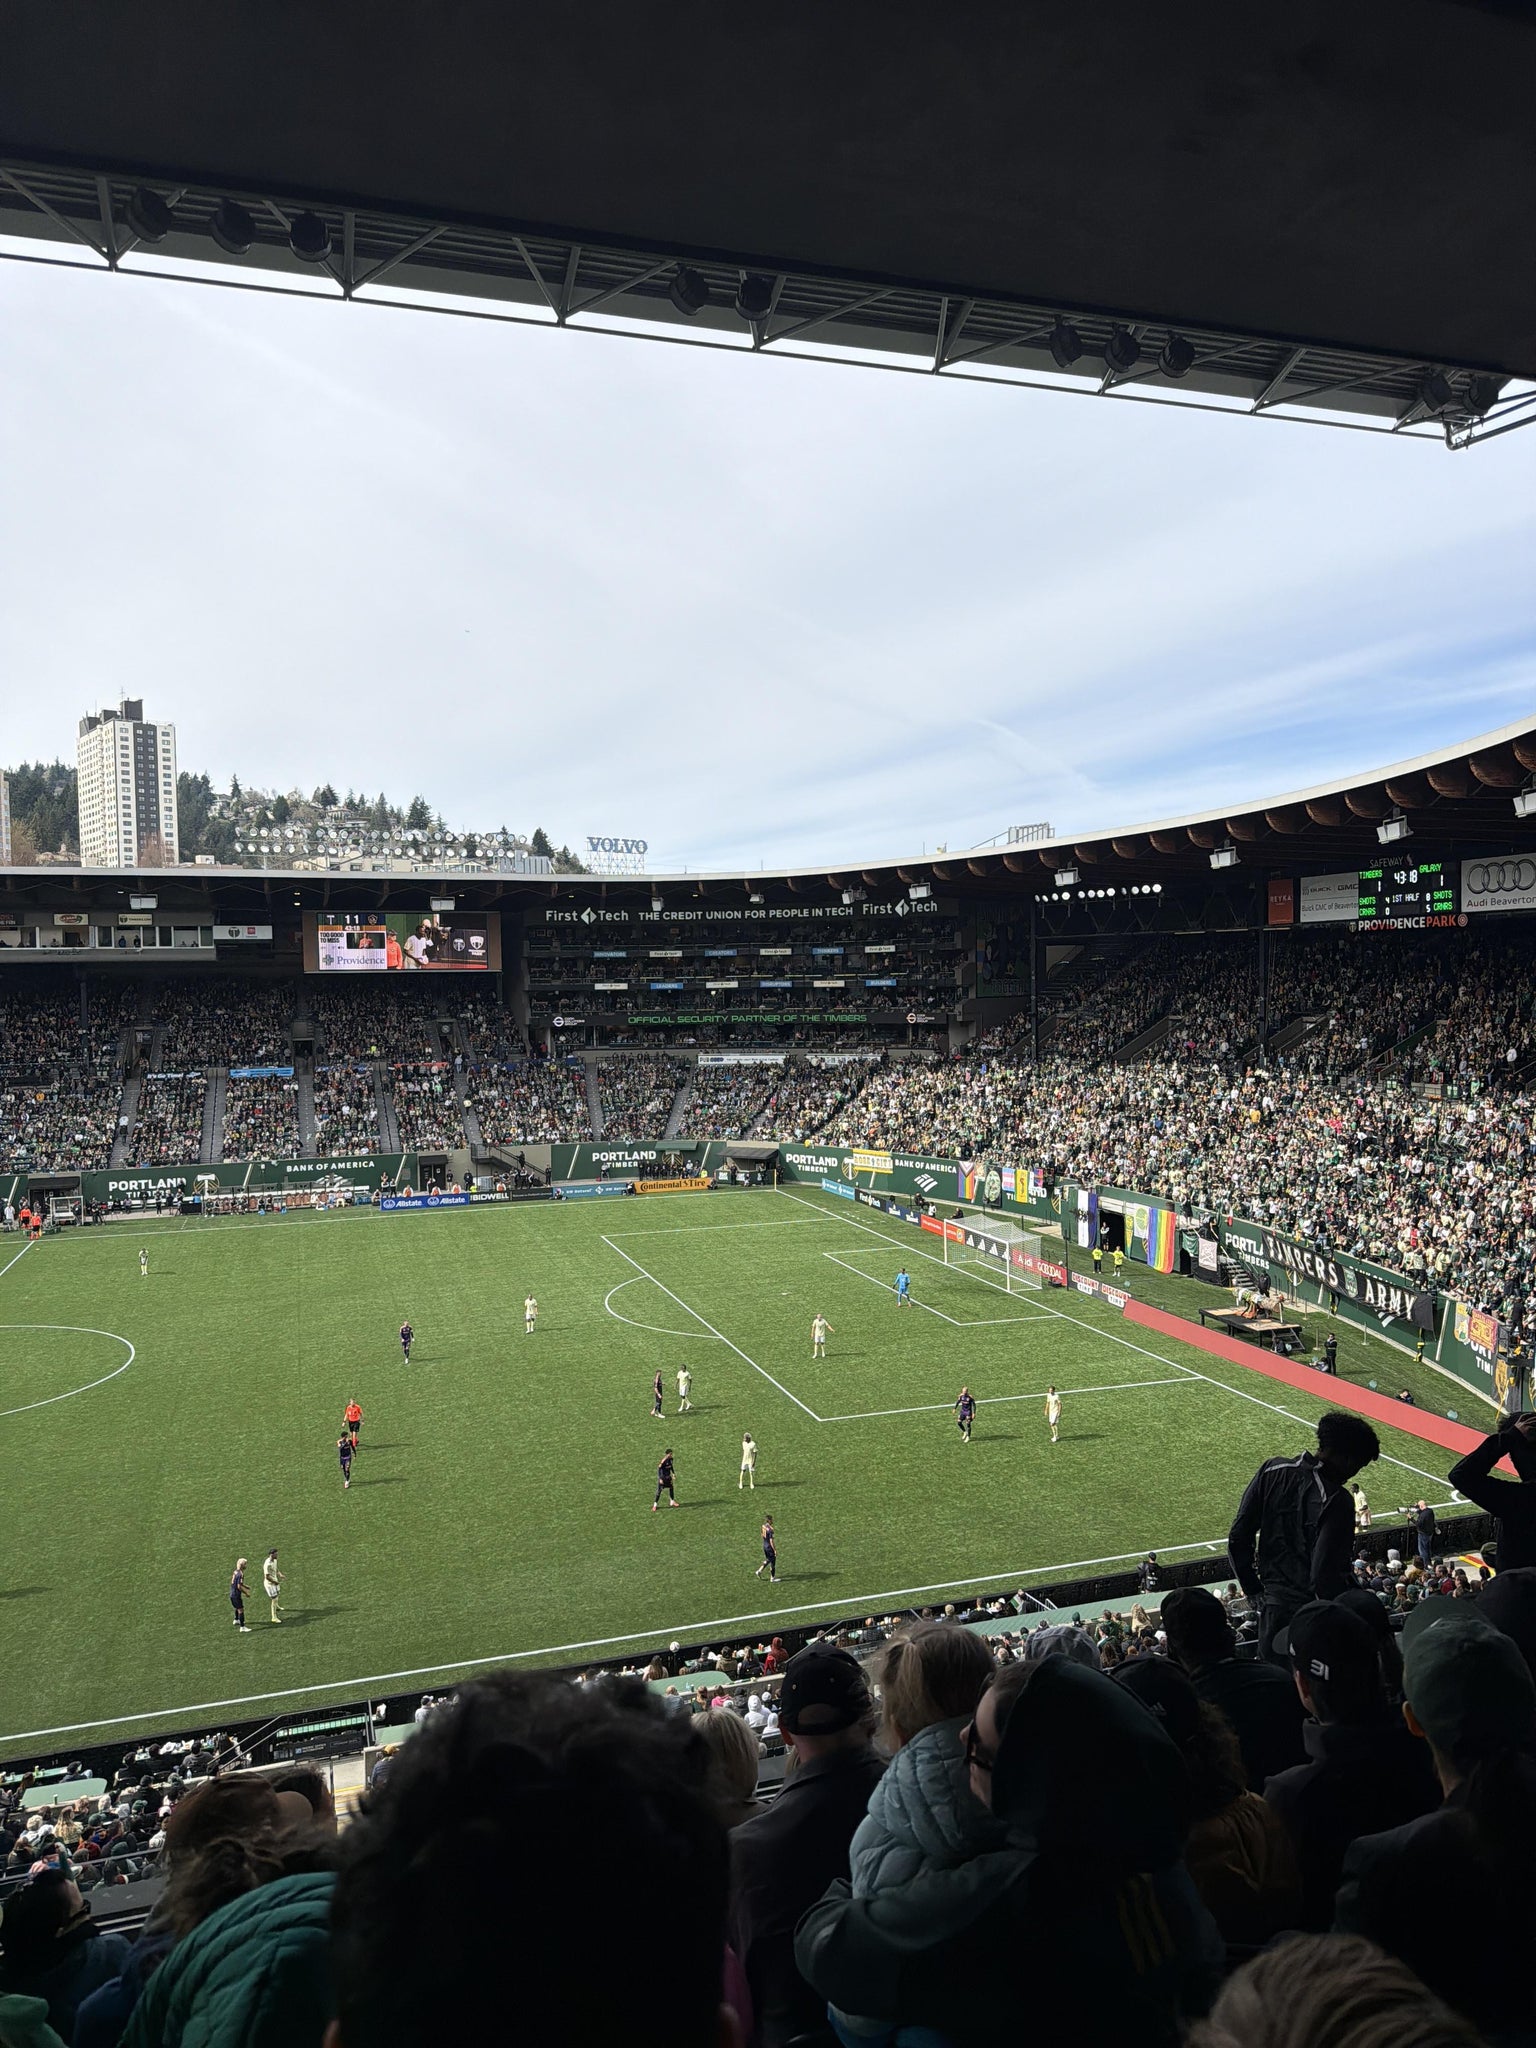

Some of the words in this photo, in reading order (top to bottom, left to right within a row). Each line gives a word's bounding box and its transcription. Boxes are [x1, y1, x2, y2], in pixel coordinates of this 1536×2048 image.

[586, 836, 648, 854] VOLVO
[1370, 857, 1404, 868] SAFEWAY
[1360, 896, 1376, 906] SHOTS
[1385, 896, 1390, 904] 4
[1405, 892, 1420, 902] HALF
[1426, 892, 1430, 902] 8
[1433, 890, 1453, 900] SHOTS
[1467, 899, 1488, 907] Audi
[862, 903, 892, 914] First
[910, 901, 937, 912] Tech
[1385, 907, 1390, 916] 0
[546, 910, 578, 921] First
[598, 910, 629, 921] Tech
[639, 912, 660, 920] THE
[663, 911, 703, 920] CREDIT
[706, 910, 741, 920] UNION
[745, 910, 766, 919] FOR
[770, 909, 809, 918] PEOPLE
[812, 908, 822, 916] IN
[825, 907, 853, 916] TECH
[337, 955, 385, 965] Providence
[628, 1016, 674, 1024] OFFICIAL
[677, 1015, 729, 1023] SECURITY
[732, 1014, 781, 1022] PARTNER
[823, 1014, 867, 1022] TIMBERS
[592, 1151, 656, 1162] PORTLAND
[786, 1154, 838, 1167] PORTLAND
[330, 1161, 375, 1170] AMERICA
[797, 1164, 828, 1173] TIMBERS
[894, 1159, 914, 1168] BANK
[915, 1161, 924, 1169] OF
[925, 1161, 957, 1174] AMERICA
[640, 1181, 682, 1192] Continental
[690, 1179, 706, 1187] Tire
[395, 1198, 422, 1207] Allstate
[440, 1196, 466, 1204] Allstate
[1238, 1251, 1270, 1270] TIMBERS
[1072, 1272, 1099, 1290] DISCOUNT
[1266, 1236, 1338, 1286] TIMBERS
[1366, 1278, 1419, 1322] ARMY
[1078, 1284, 1090, 1293] TIRE
[1110, 1296, 1122, 1306] TIRE
[1310, 1659, 1330, 1680] 31
